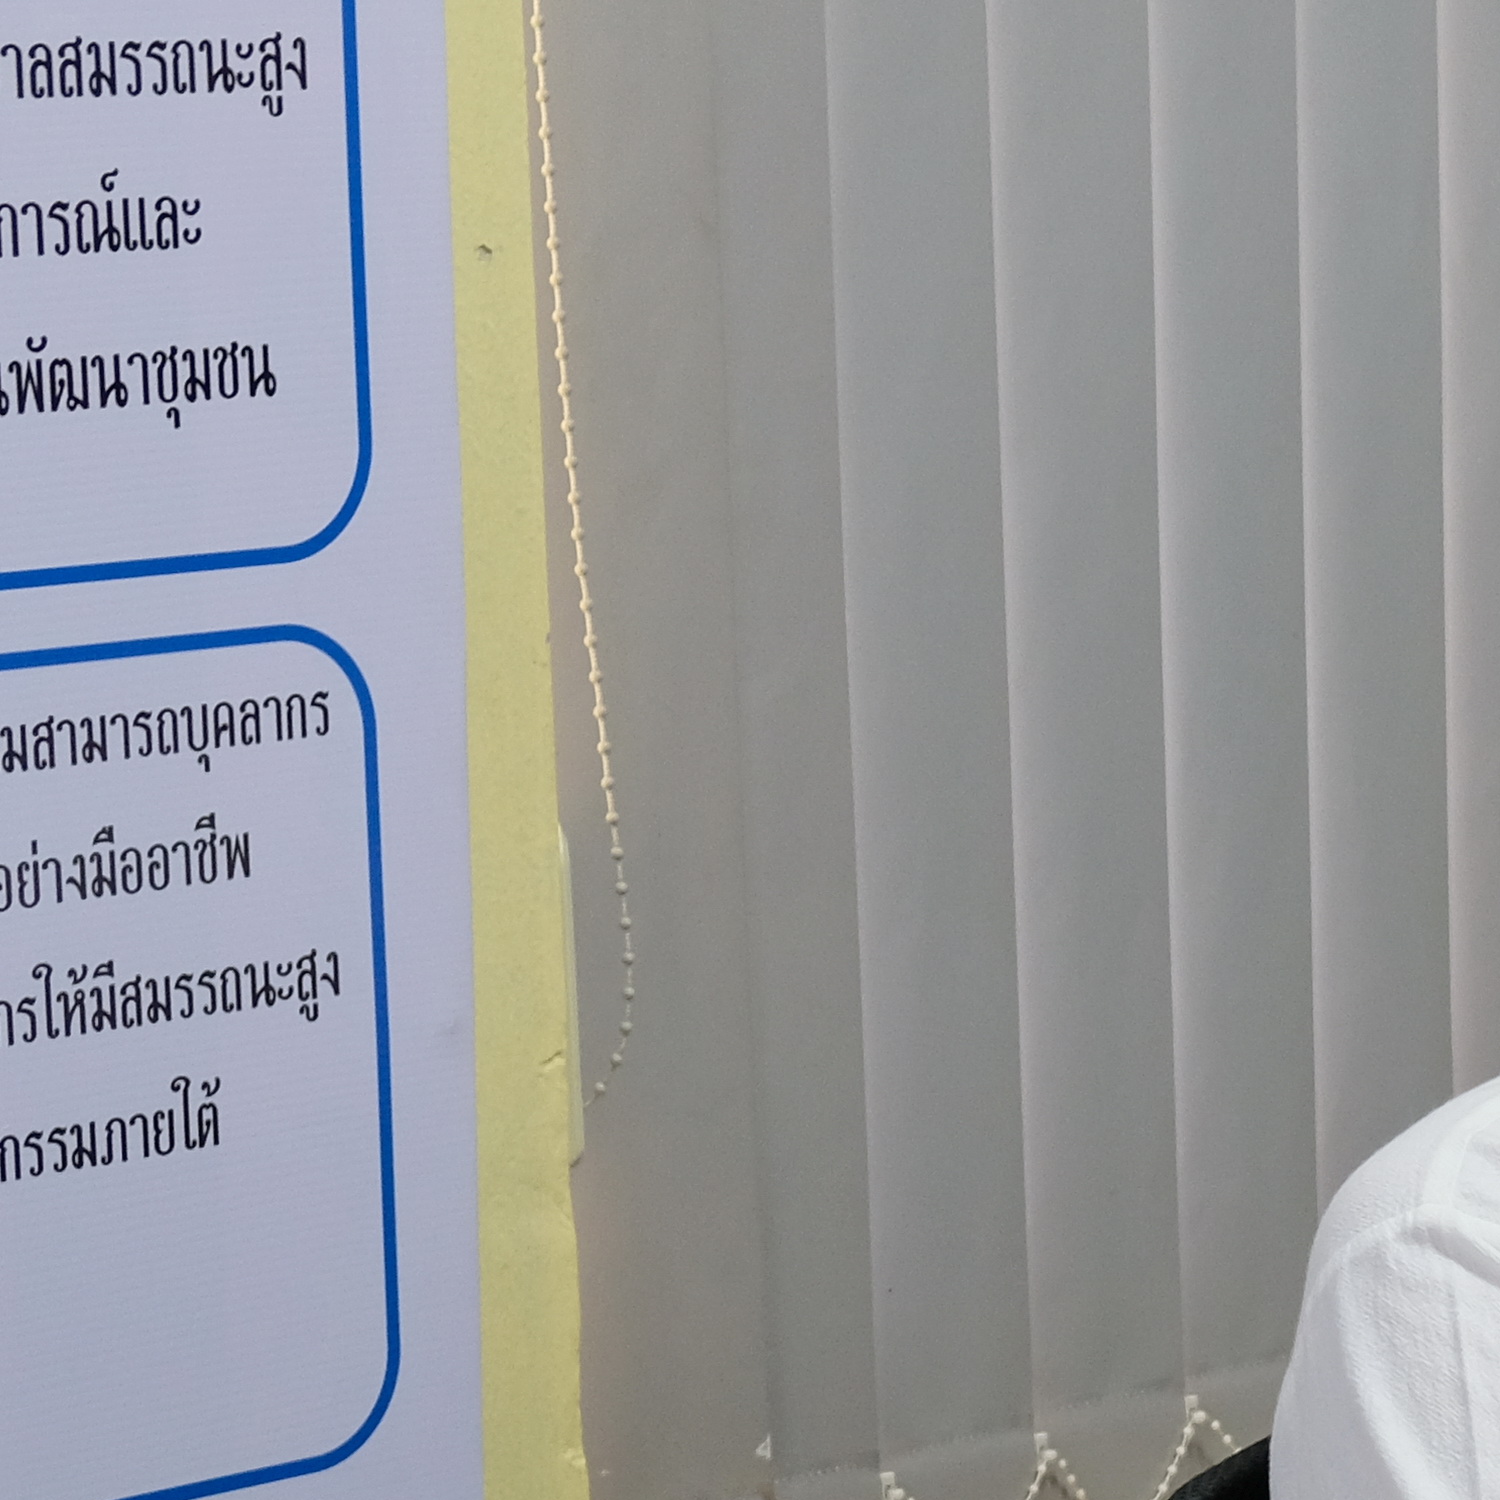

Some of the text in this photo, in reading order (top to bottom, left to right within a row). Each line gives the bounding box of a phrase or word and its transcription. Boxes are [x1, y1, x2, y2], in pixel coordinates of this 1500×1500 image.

[0, 687, 331, 773] มสามารถบุคลากร
[0, 1075, 221, 1182] กรรมภายใต้
